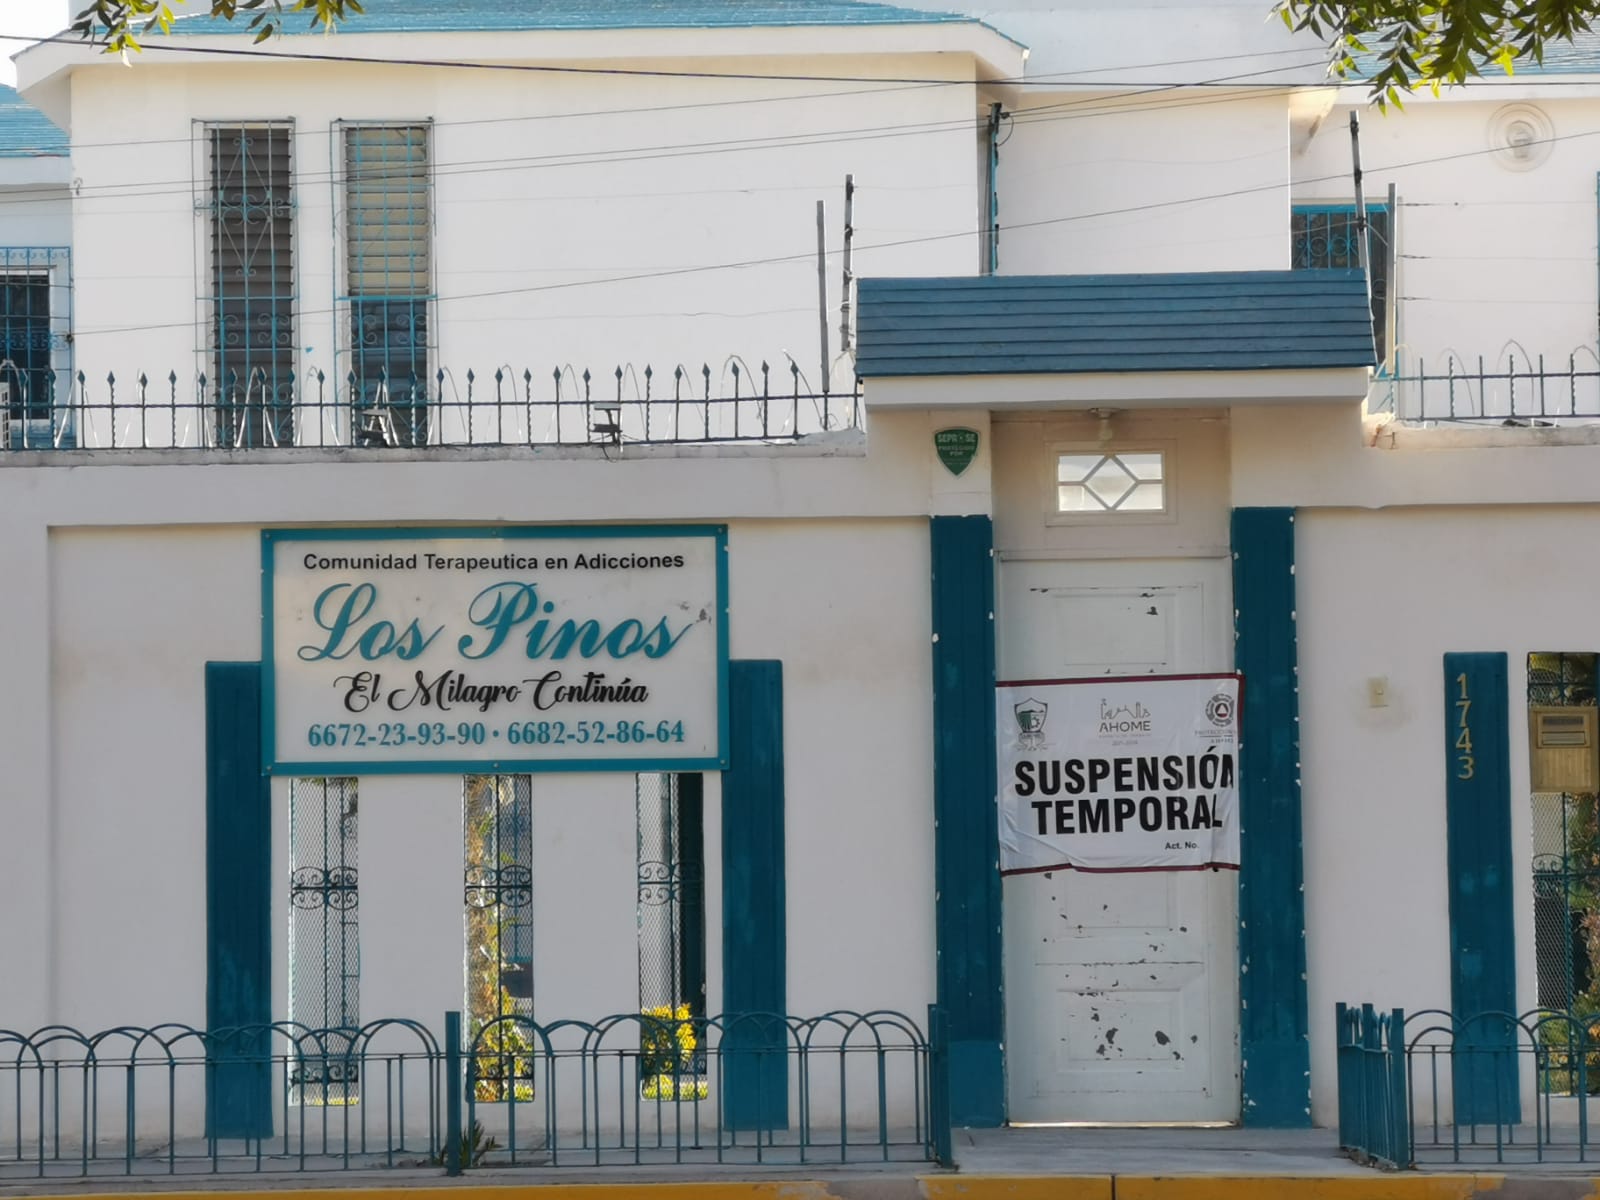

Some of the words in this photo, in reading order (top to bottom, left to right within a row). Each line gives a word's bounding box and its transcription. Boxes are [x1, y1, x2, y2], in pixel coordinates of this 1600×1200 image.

[303, 553, 418, 570] Comunidad
[423, 553, 539, 573] Terapeutica
[544, 556, 568, 570] en
[574, 553, 685, 569] Adicciones
[297, 582, 446, 661] Los
[457, 581, 694, 660] Pinos
[333, 671, 381, 713] El
[387, 670, 522, 713] Milagro
[522, 670, 650, 711] Continúa
[307, 722, 486, 747] 6672-23-93-90
[507, 720, 685, 744] 6682-52-86-64
[1099, 720, 1151, 733] AHOME
[1455, 672, 1475, 780] 1743
[1031, 794, 1223, 836] TEMPORAL
[1165, 841, 1182, 850] Act.
[1185, 841, 1200, 850] No.
